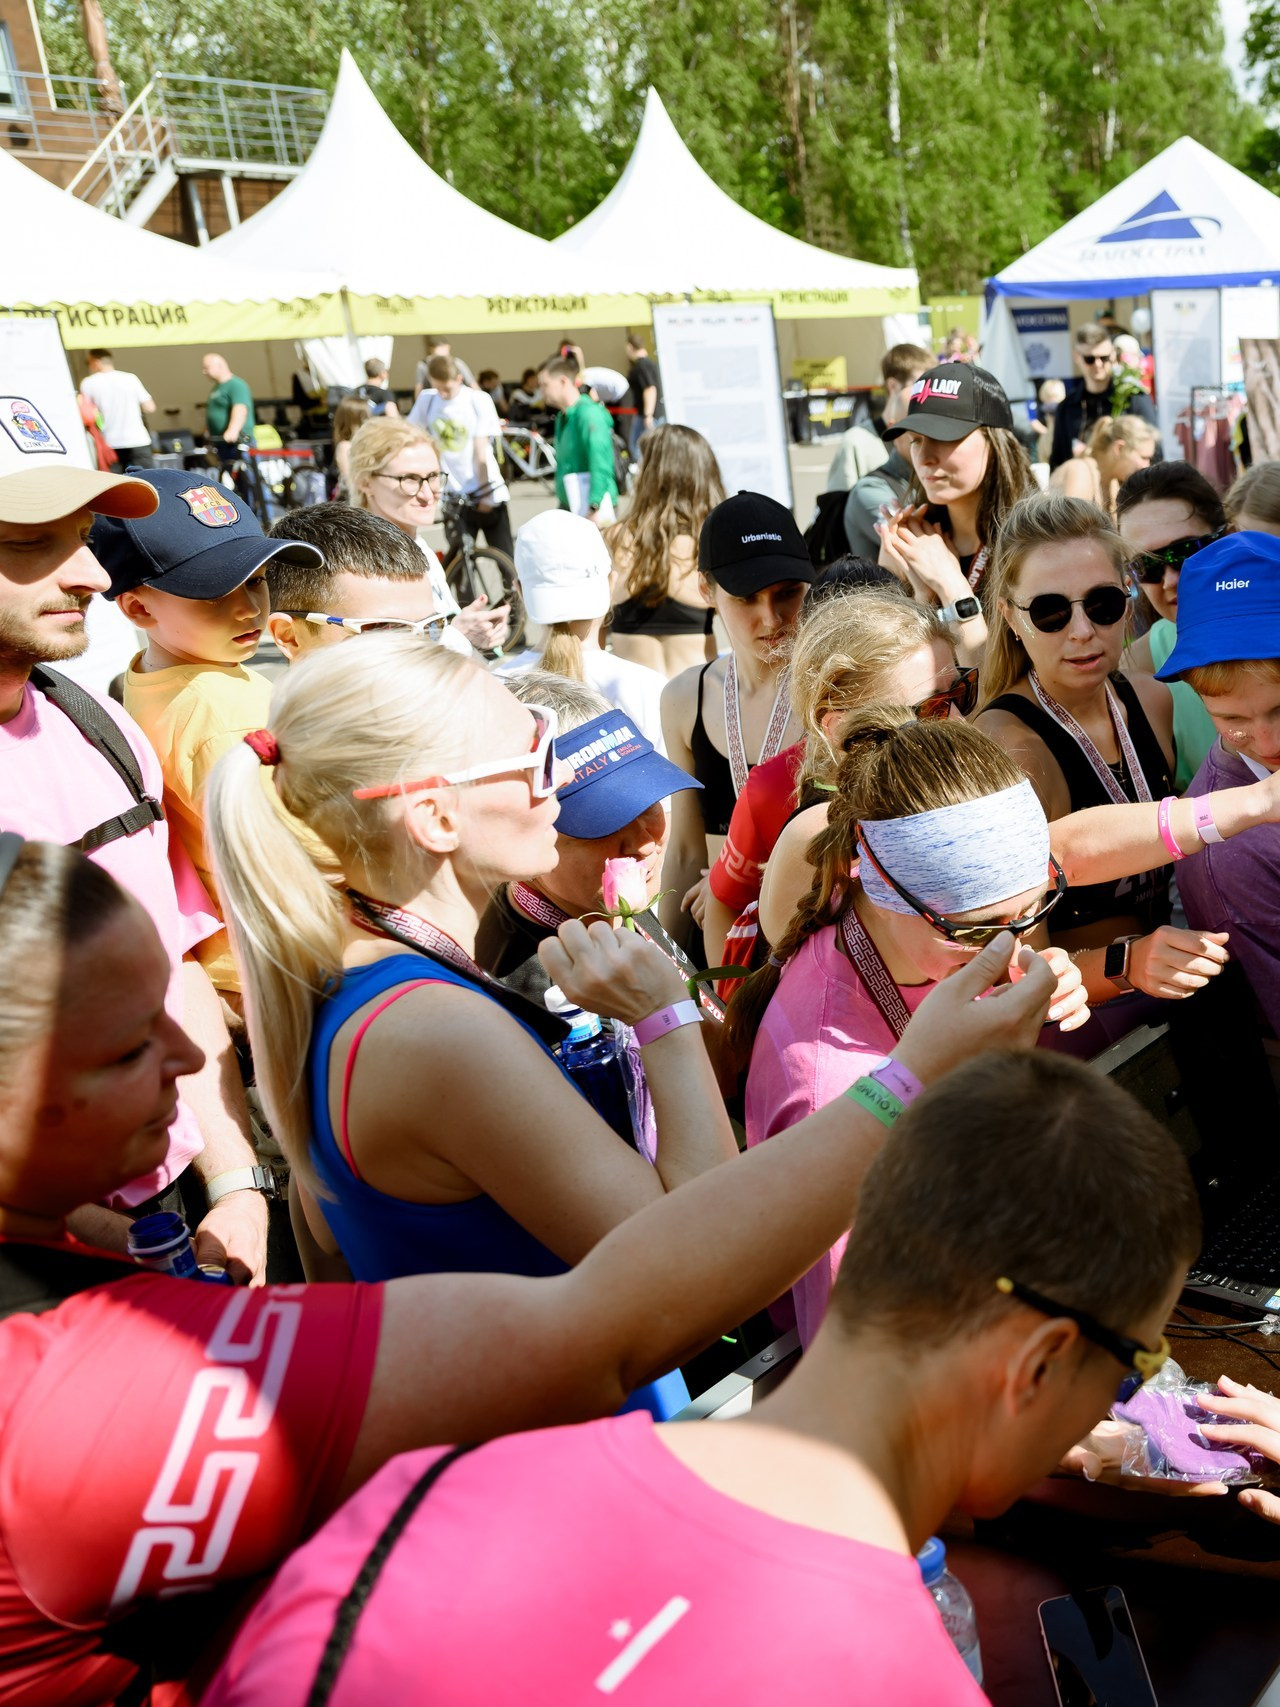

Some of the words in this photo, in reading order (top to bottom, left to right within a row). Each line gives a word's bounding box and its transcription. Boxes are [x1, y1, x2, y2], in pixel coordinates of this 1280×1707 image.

[24, 305, 188, 328] ИСТРАЦИЯ
[931, 378, 961, 395] LADY
[203, 500, 221, 509] FCB
[741, 532, 782, 544] Urbanistic
[1215, 578, 1250, 592] Haier
